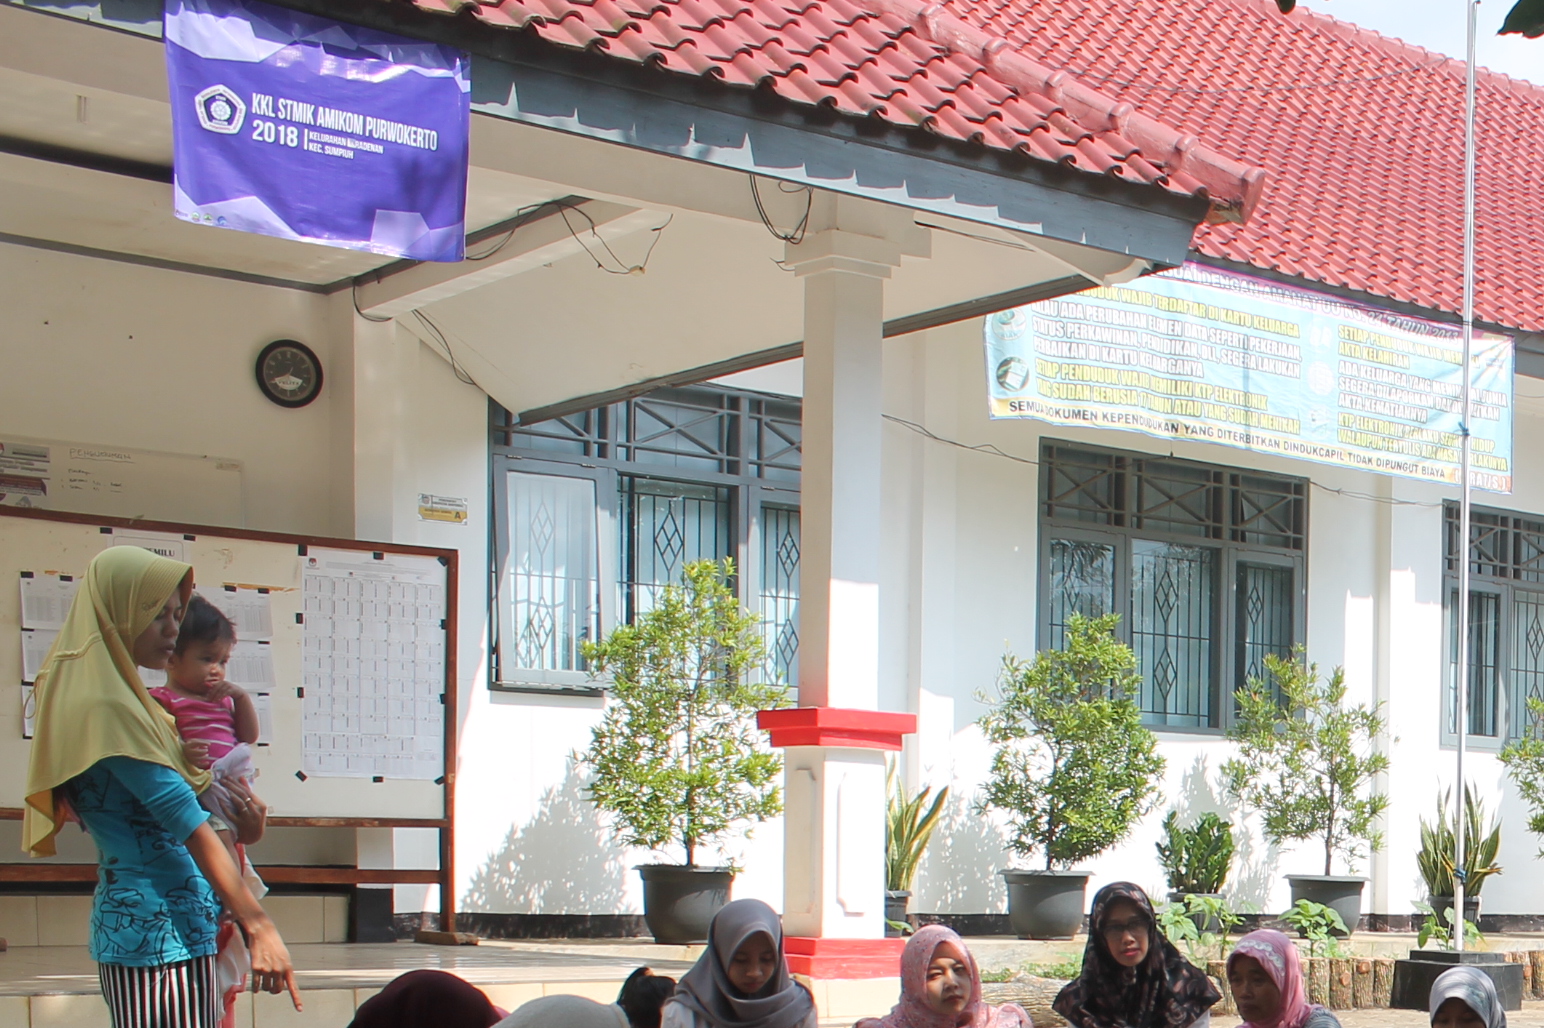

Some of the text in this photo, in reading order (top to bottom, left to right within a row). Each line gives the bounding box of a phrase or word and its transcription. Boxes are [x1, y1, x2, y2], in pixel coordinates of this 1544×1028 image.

[252, 92, 275, 117] KKL
[278, 98, 315, 125] STMIK
[316, 106, 364, 136] AMIKOM
[365, 113, 438, 151] PURWOKERTO
[252, 119, 298, 147] 2018
[309, 131, 346, 146] KELURAHAN
[309, 142, 354, 159] KEC. SUMPIUH
[1119, 288, 1153, 307] WAJIB
[1154, 294, 1206, 318] TERDAFTAR
[1208, 305, 1219, 321] DI
[1220, 307, 1252, 327] KARTU
[1253, 313, 1300, 338] KELUARGA
[1367, 311, 1384, 325] 24
[1386, 315, 1430, 335] TAHUN
[1430, 327, 1460, 344] 2013
[1032, 316, 1065, 338] STATUS
[1066, 322, 1141, 348] PERKAWINAN,
[1220, 348, 1257, 370] SEGERA
[1258, 356, 1300, 379] LAKUKAN
[1060, 302, 1085, 319] ADA
[1086, 305, 1148, 330] PERUBAHAN
[1149, 314, 1183, 337] ELEMEN
[1184, 321, 1209, 342] DATA
[1209, 327, 1249, 350] SEPERTI
[1249, 336, 1302, 362] PEKERJAAN,
[1338, 325, 1369, 342] SETIAP
[1370, 332, 1414, 356] PENDUDUK
[1415, 344, 1443, 361] WAJIB
[1033, 335, 1087, 360] PERBAIKAN
[1088, 344, 1100, 361] DI
[1101, 345, 1139, 366] KARTU
[1139, 351, 1204, 379] KELUARGANYA
[1338, 342, 1410, 369] AKTA KELAHIRAN
[1036, 358, 1268, 411] SETIAP PENDUDUK WAJIB MEMILIKI KTP ELEKTRONIK
[1338, 360, 1360, 377] ADA
[1360, 364, 1408, 387] KELUARGA
[1408, 374, 1432, 392] YANG
[1338, 376, 1376, 397] SEGERA
[1376, 383, 1434, 406] DILAPORKAN
[1053, 382, 1092, 401] SUDAH
[1093, 387, 1138, 406] BERUSIA
[1148, 394, 1173, 415] TAHUN
[1173, 398, 1202, 417] ATAU
[1202, 402, 1228, 422] YANG
[1228, 408, 1260, 427] SUDAH
[1260, 413, 1301, 436] MENIKAH
[1338, 393, 1428, 424] AKTA KEMATIANNYA
[1009, 401, 1045, 413] SEMUA
[1045, 407, 1098, 421] DOKUMEN
[1102, 412, 1179, 434] KEPENDUDUKAN
[1183, 424, 1214, 438] YANG
[1217, 429, 1281, 449] DITERBITKAN
[1283, 441, 1345, 461] DINDUKCAPIL
[1347, 453, 1373, 466] TIDAK
[1376, 458, 1420, 474] DIPUNGUT
[1421, 466, 1446, 479] BIAYA
[1337, 429, 1385, 449] WALAUPUN
[1421, 443, 1436, 459] ADA
[1338, 412, 1355, 428] KTP
[1355, 415, 1404, 438] ELEKTRONIK
[1470, 437, 1496, 453] HIDUP
